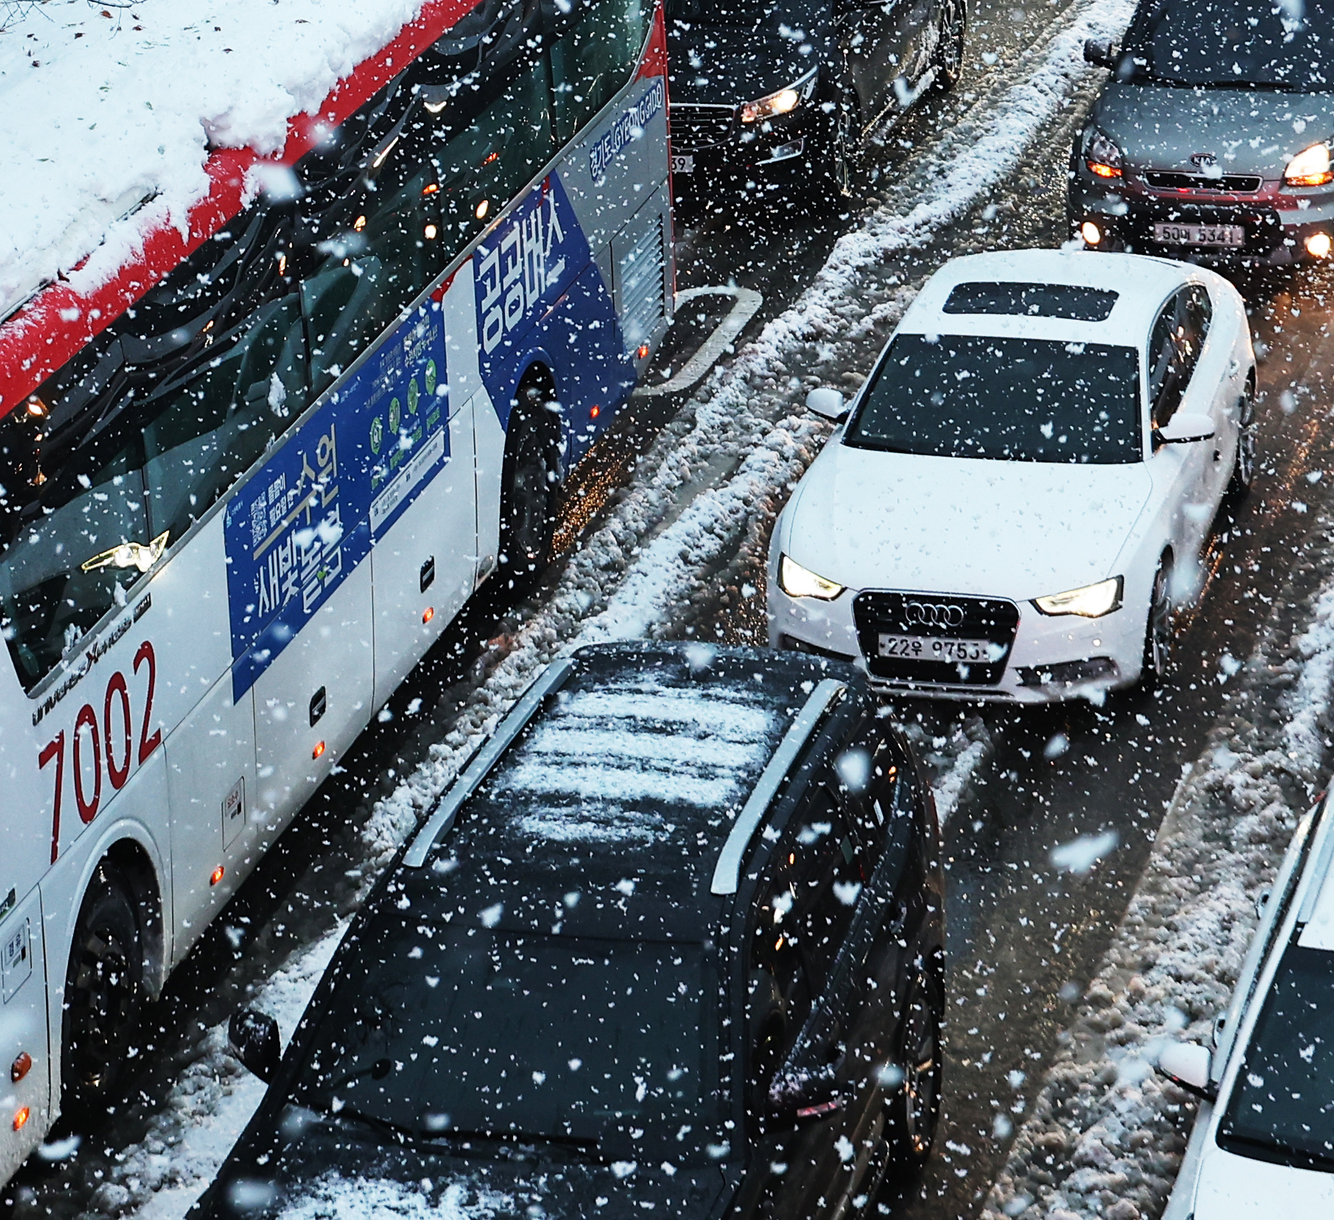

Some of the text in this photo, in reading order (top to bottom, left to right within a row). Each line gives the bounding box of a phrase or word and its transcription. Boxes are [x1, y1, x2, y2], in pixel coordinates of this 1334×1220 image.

[479, 189, 565, 356] 공공버스
[888, 637, 923, 657] 22우
[38, 640, 162, 866] 7002
